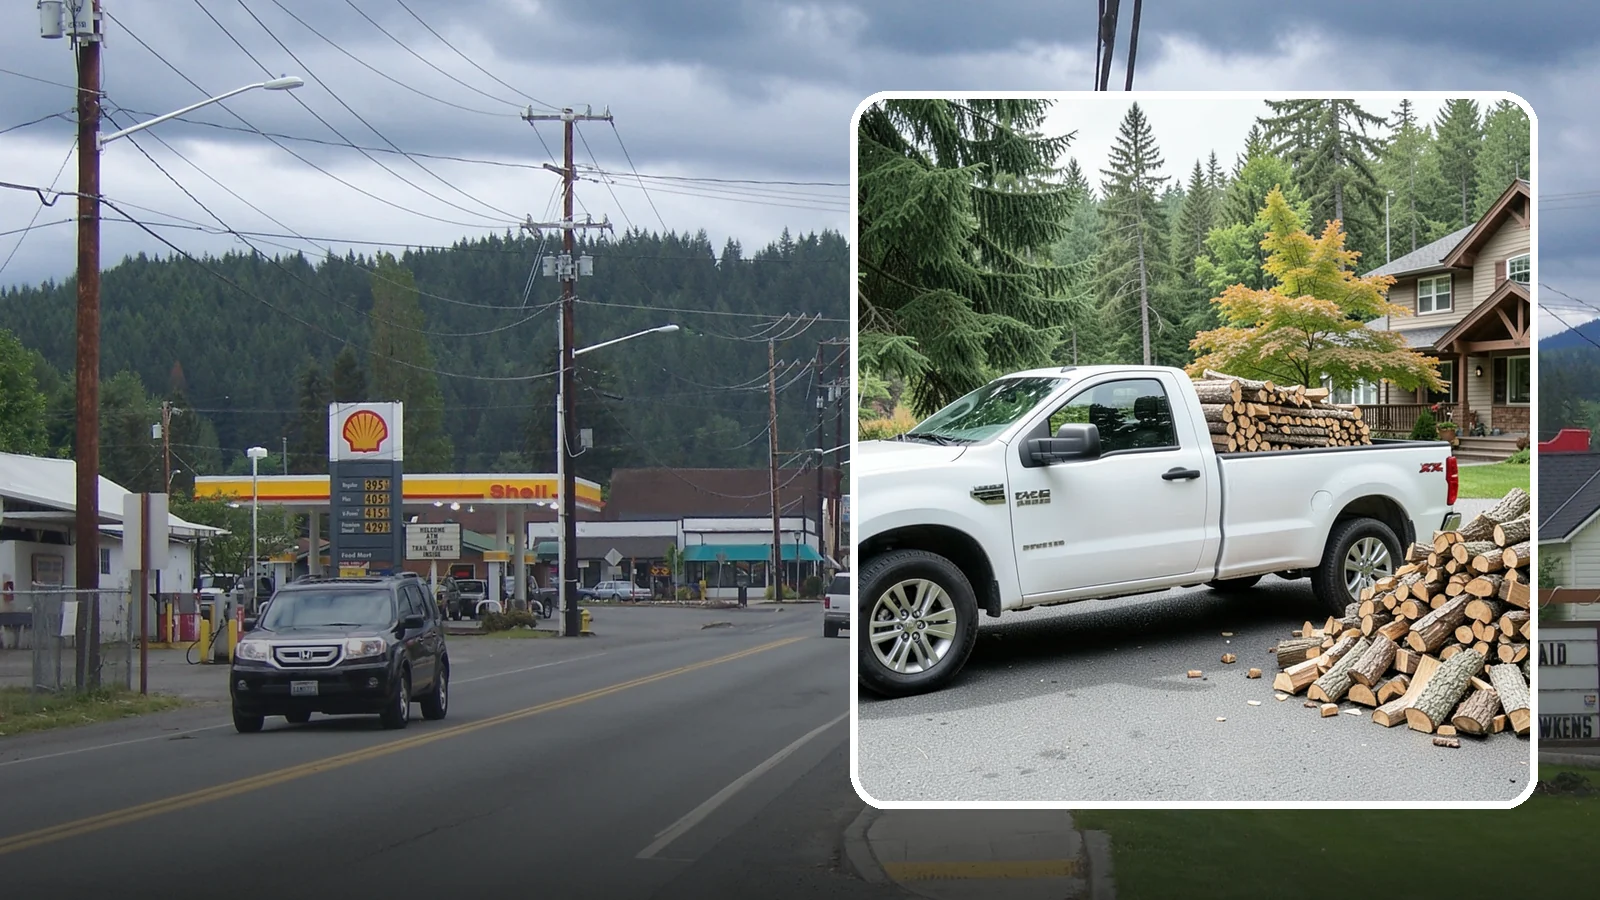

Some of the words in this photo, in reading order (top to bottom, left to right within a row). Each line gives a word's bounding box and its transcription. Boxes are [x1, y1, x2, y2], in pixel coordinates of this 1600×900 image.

[366, 480, 383, 490] 395
[490, 484, 547, 499] Shell
[365, 494, 383, 504] 405
[365, 508, 383, 518] 415
[366, 522, 383, 532] 429
[1540, 643, 1566, 665] AID
